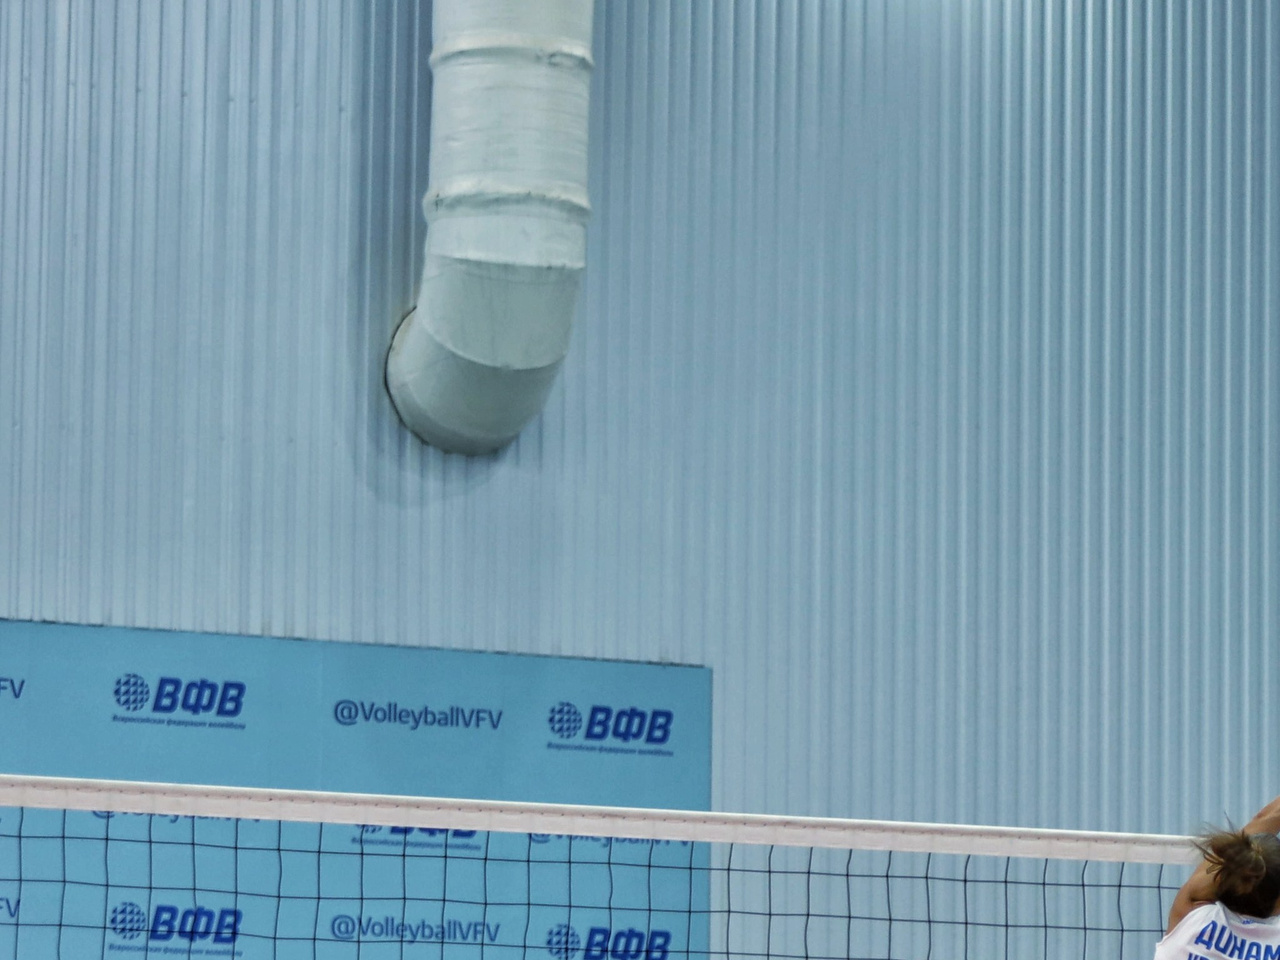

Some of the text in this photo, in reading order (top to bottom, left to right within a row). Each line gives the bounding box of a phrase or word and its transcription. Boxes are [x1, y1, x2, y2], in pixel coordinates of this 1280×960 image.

[152, 676, 247, 718] ВФВ
[334, 699, 503, 731] @VolleyballVFV
[584, 704, 674, 745] ВФВ
[149, 904, 243, 945] ВФВ
[331, 914, 501, 946] @VolleyballVFV
